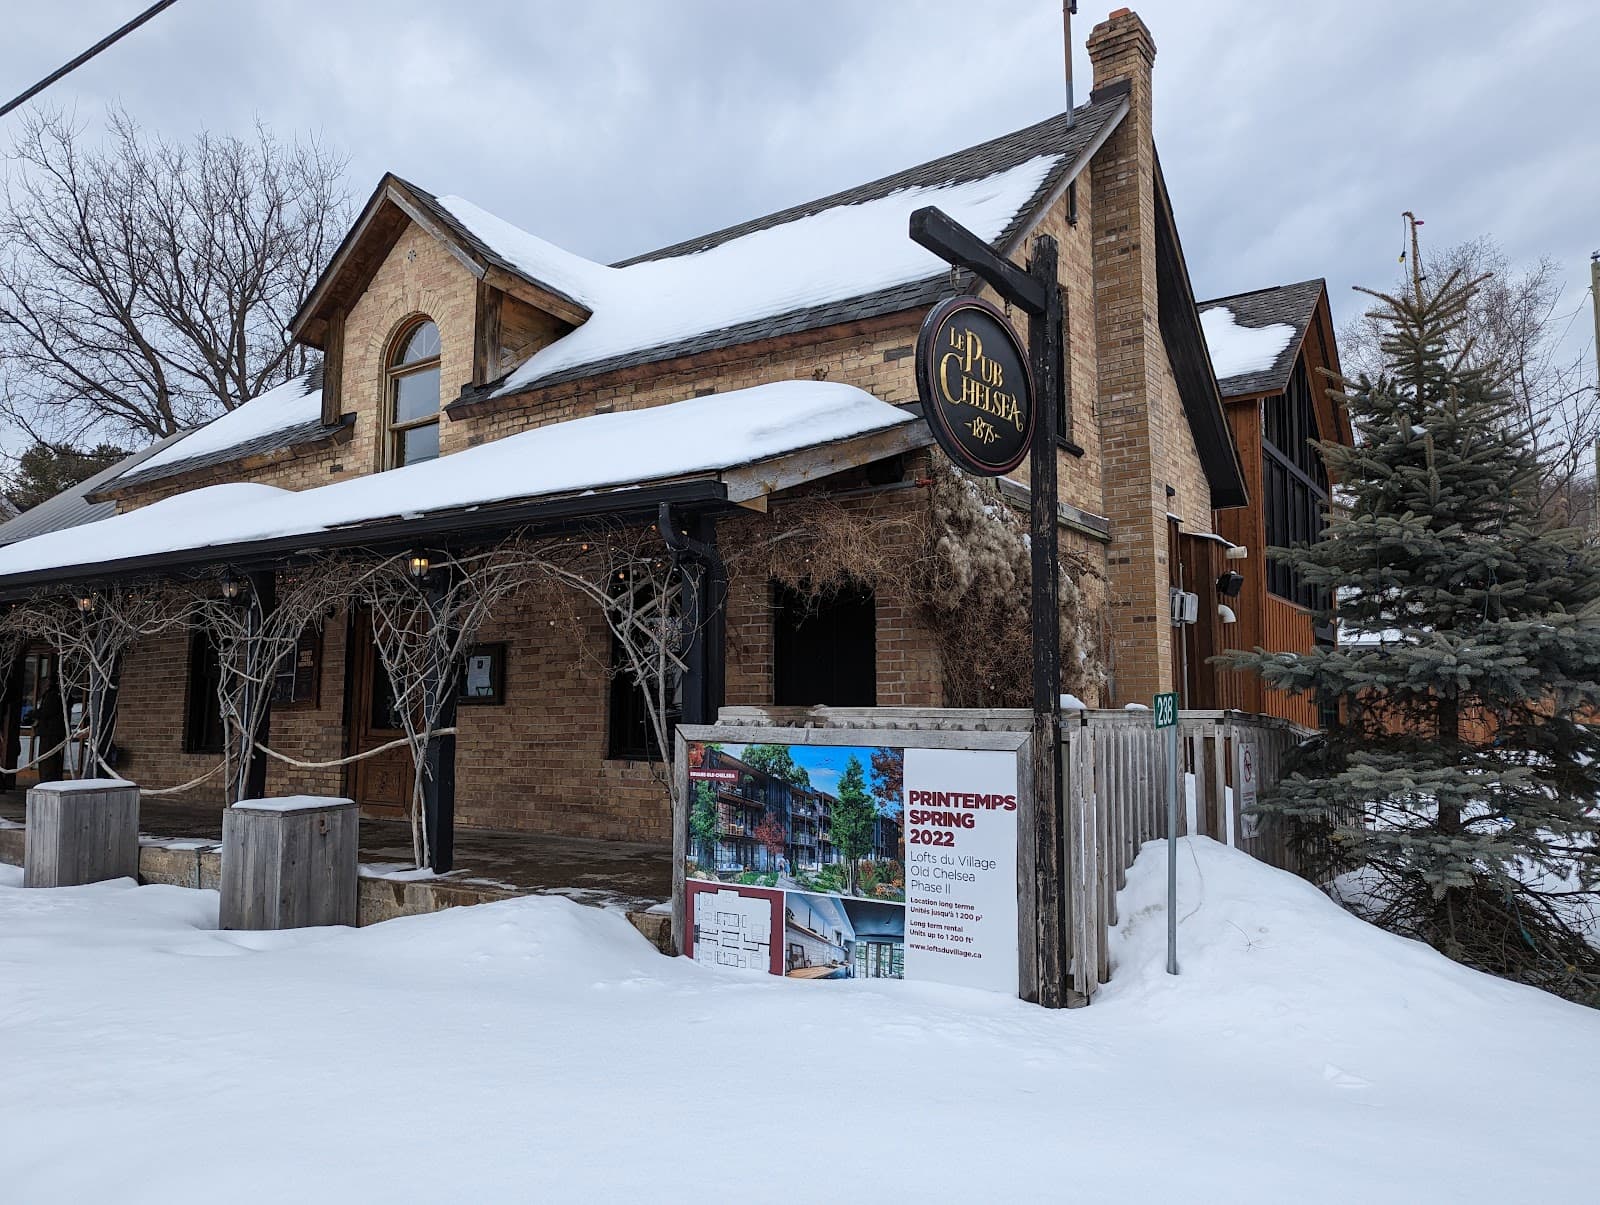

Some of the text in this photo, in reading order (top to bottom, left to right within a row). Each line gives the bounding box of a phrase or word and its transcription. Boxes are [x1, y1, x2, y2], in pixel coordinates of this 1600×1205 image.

[949, 327, 1004, 388] LE PUB
[940, 352, 1024, 433] CHELSEA
[1157, 695, 1173, 725] 238
[909, 790, 1017, 811] PRINTEMPS
[909, 809, 975, 829] SPRING
[910, 828, 955, 848] 2022
[910, 850, 997, 871] Lofts du Village
[910, 865, 976, 882] Old Chelsea
[911, 880, 942, 893] Phase
[910, 897, 975, 911] Location long terme
[910, 906, 930, 915] Unités
[909, 929, 926, 937] Units
[910, 919, 964, 933] Long term rental
[909, 943, 982, 959] www.loftsduvillage.ca
